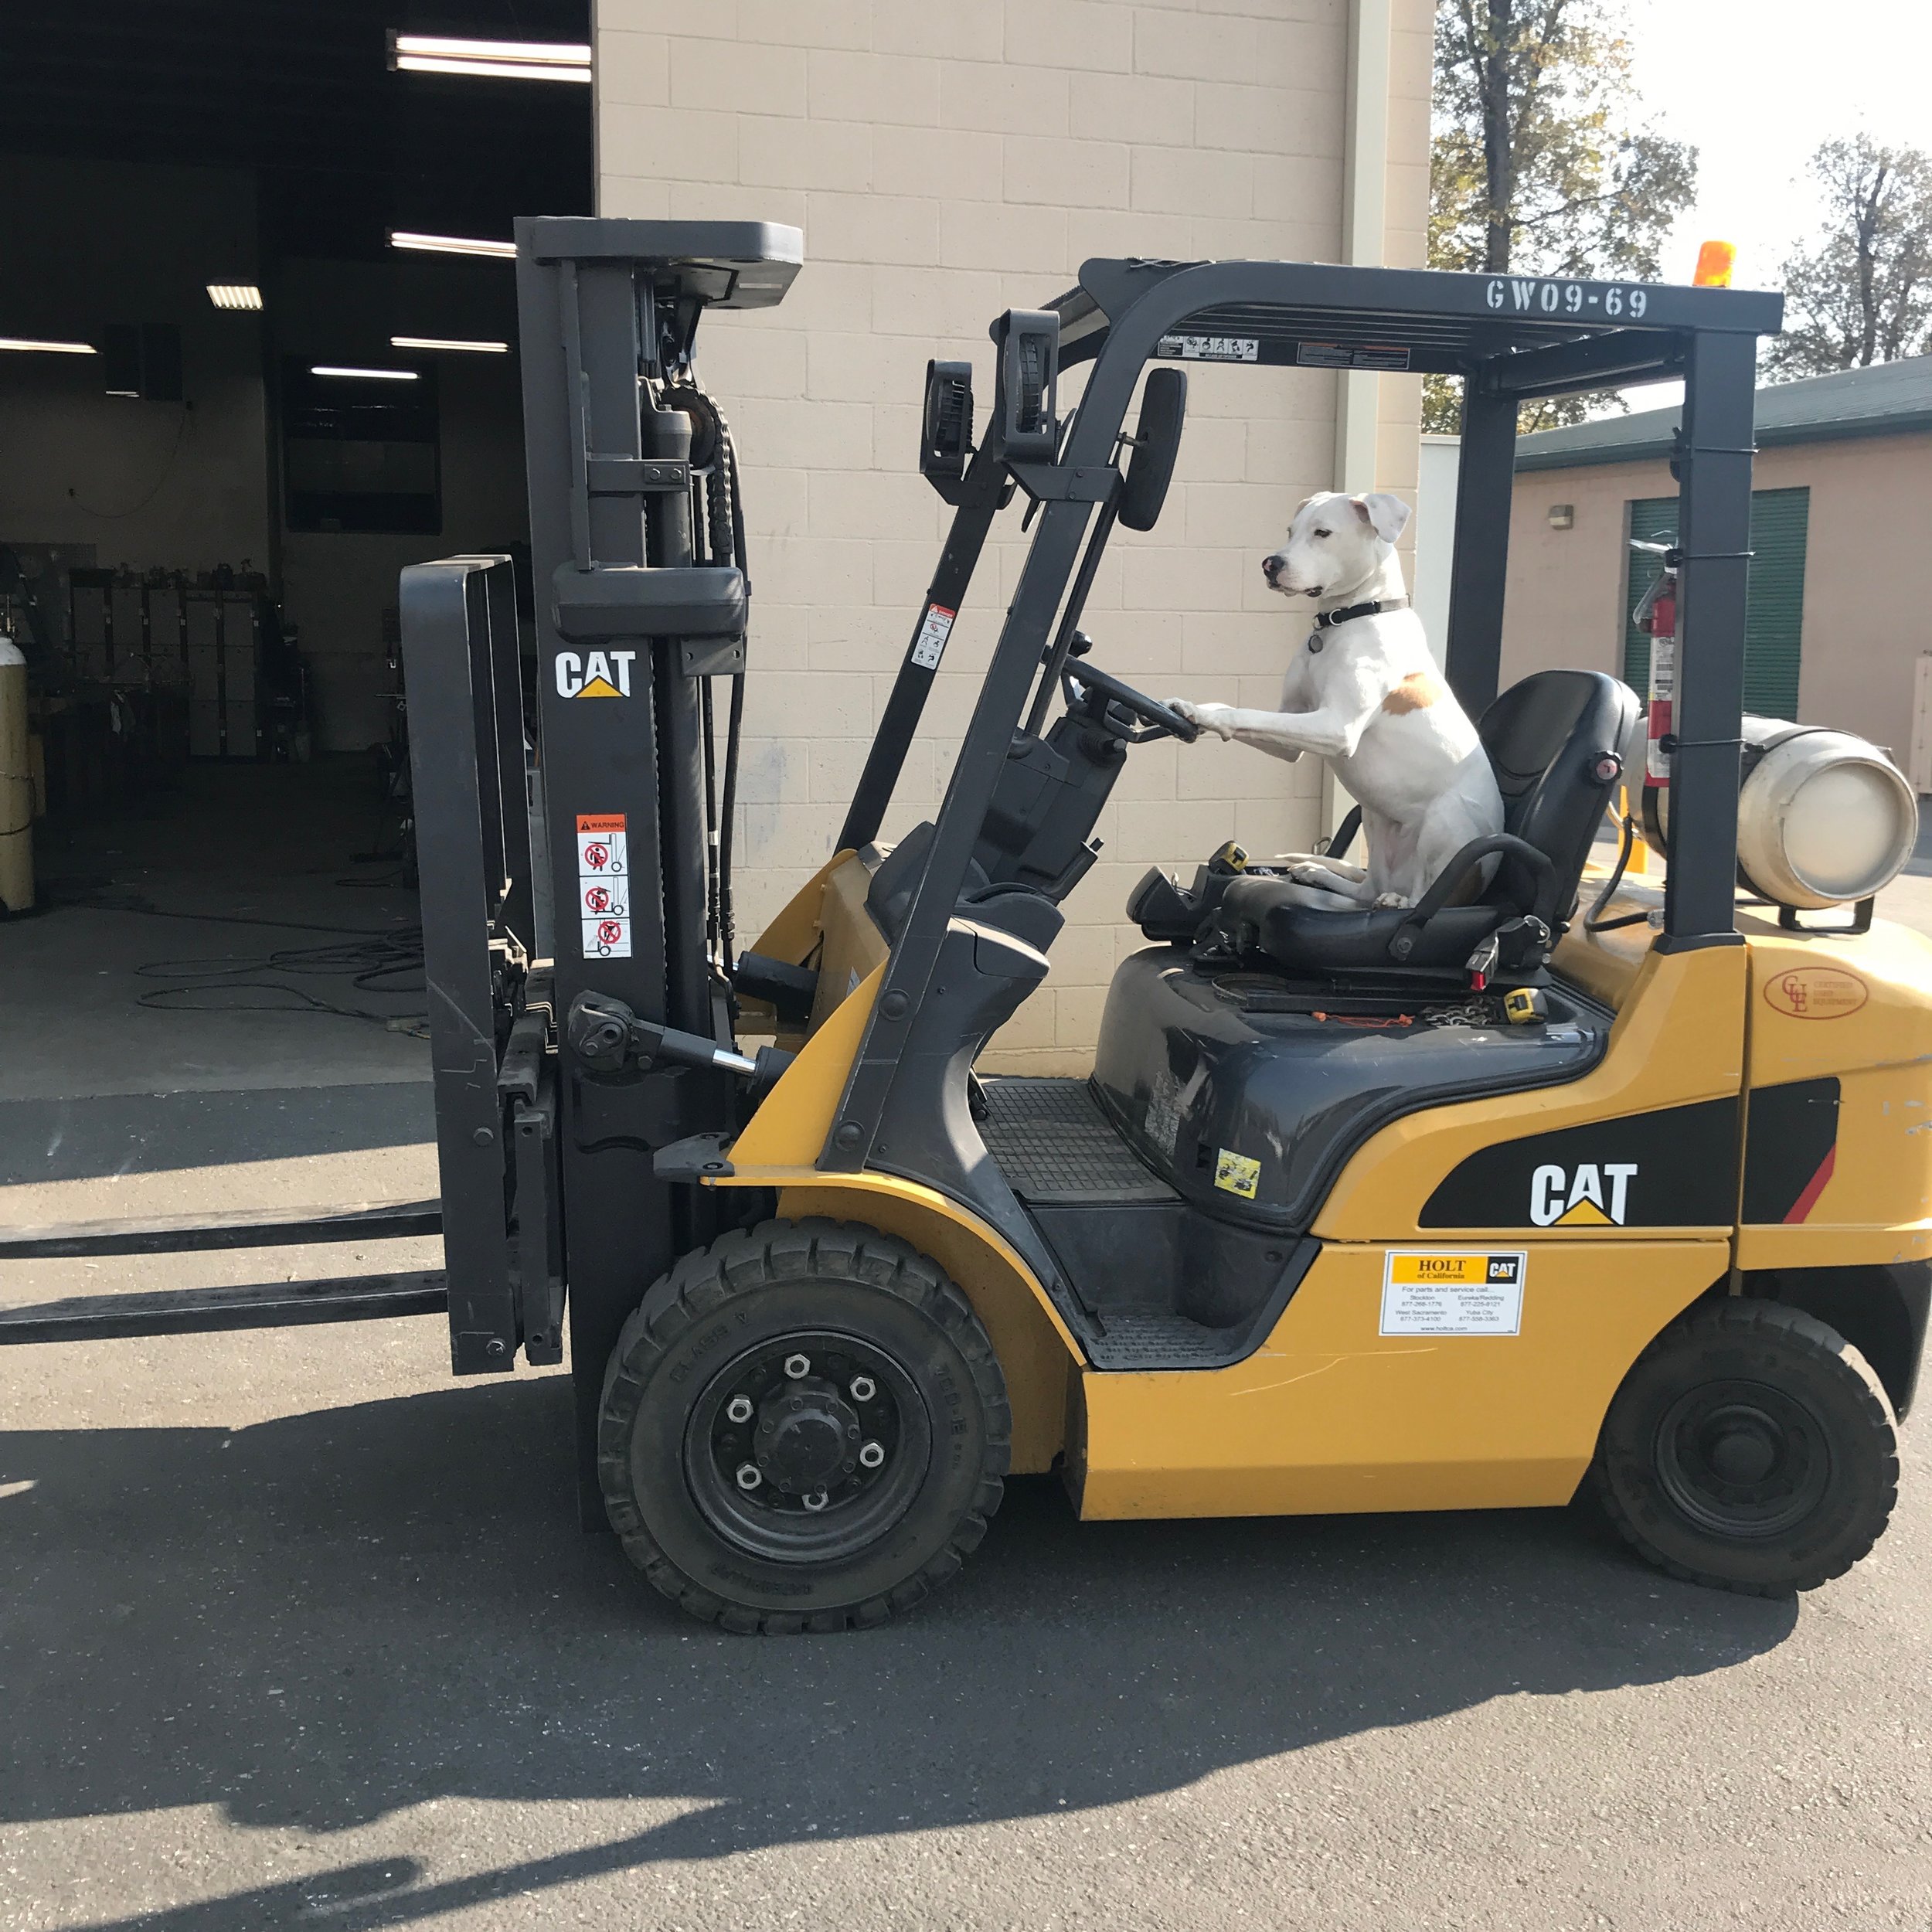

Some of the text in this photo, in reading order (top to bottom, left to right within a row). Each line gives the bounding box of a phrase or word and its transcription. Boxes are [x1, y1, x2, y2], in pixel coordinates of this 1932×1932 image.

[1486, 280, 1647, 318] GW09-69
[554, 651, 636, 699] CAT
[590, 821, 624, 829] WARNING
[1530, 1164, 1638, 1226] CAT
[1419, 1260, 1467, 1272] HOLT
[1489, 1262, 1516, 1277] CAT
